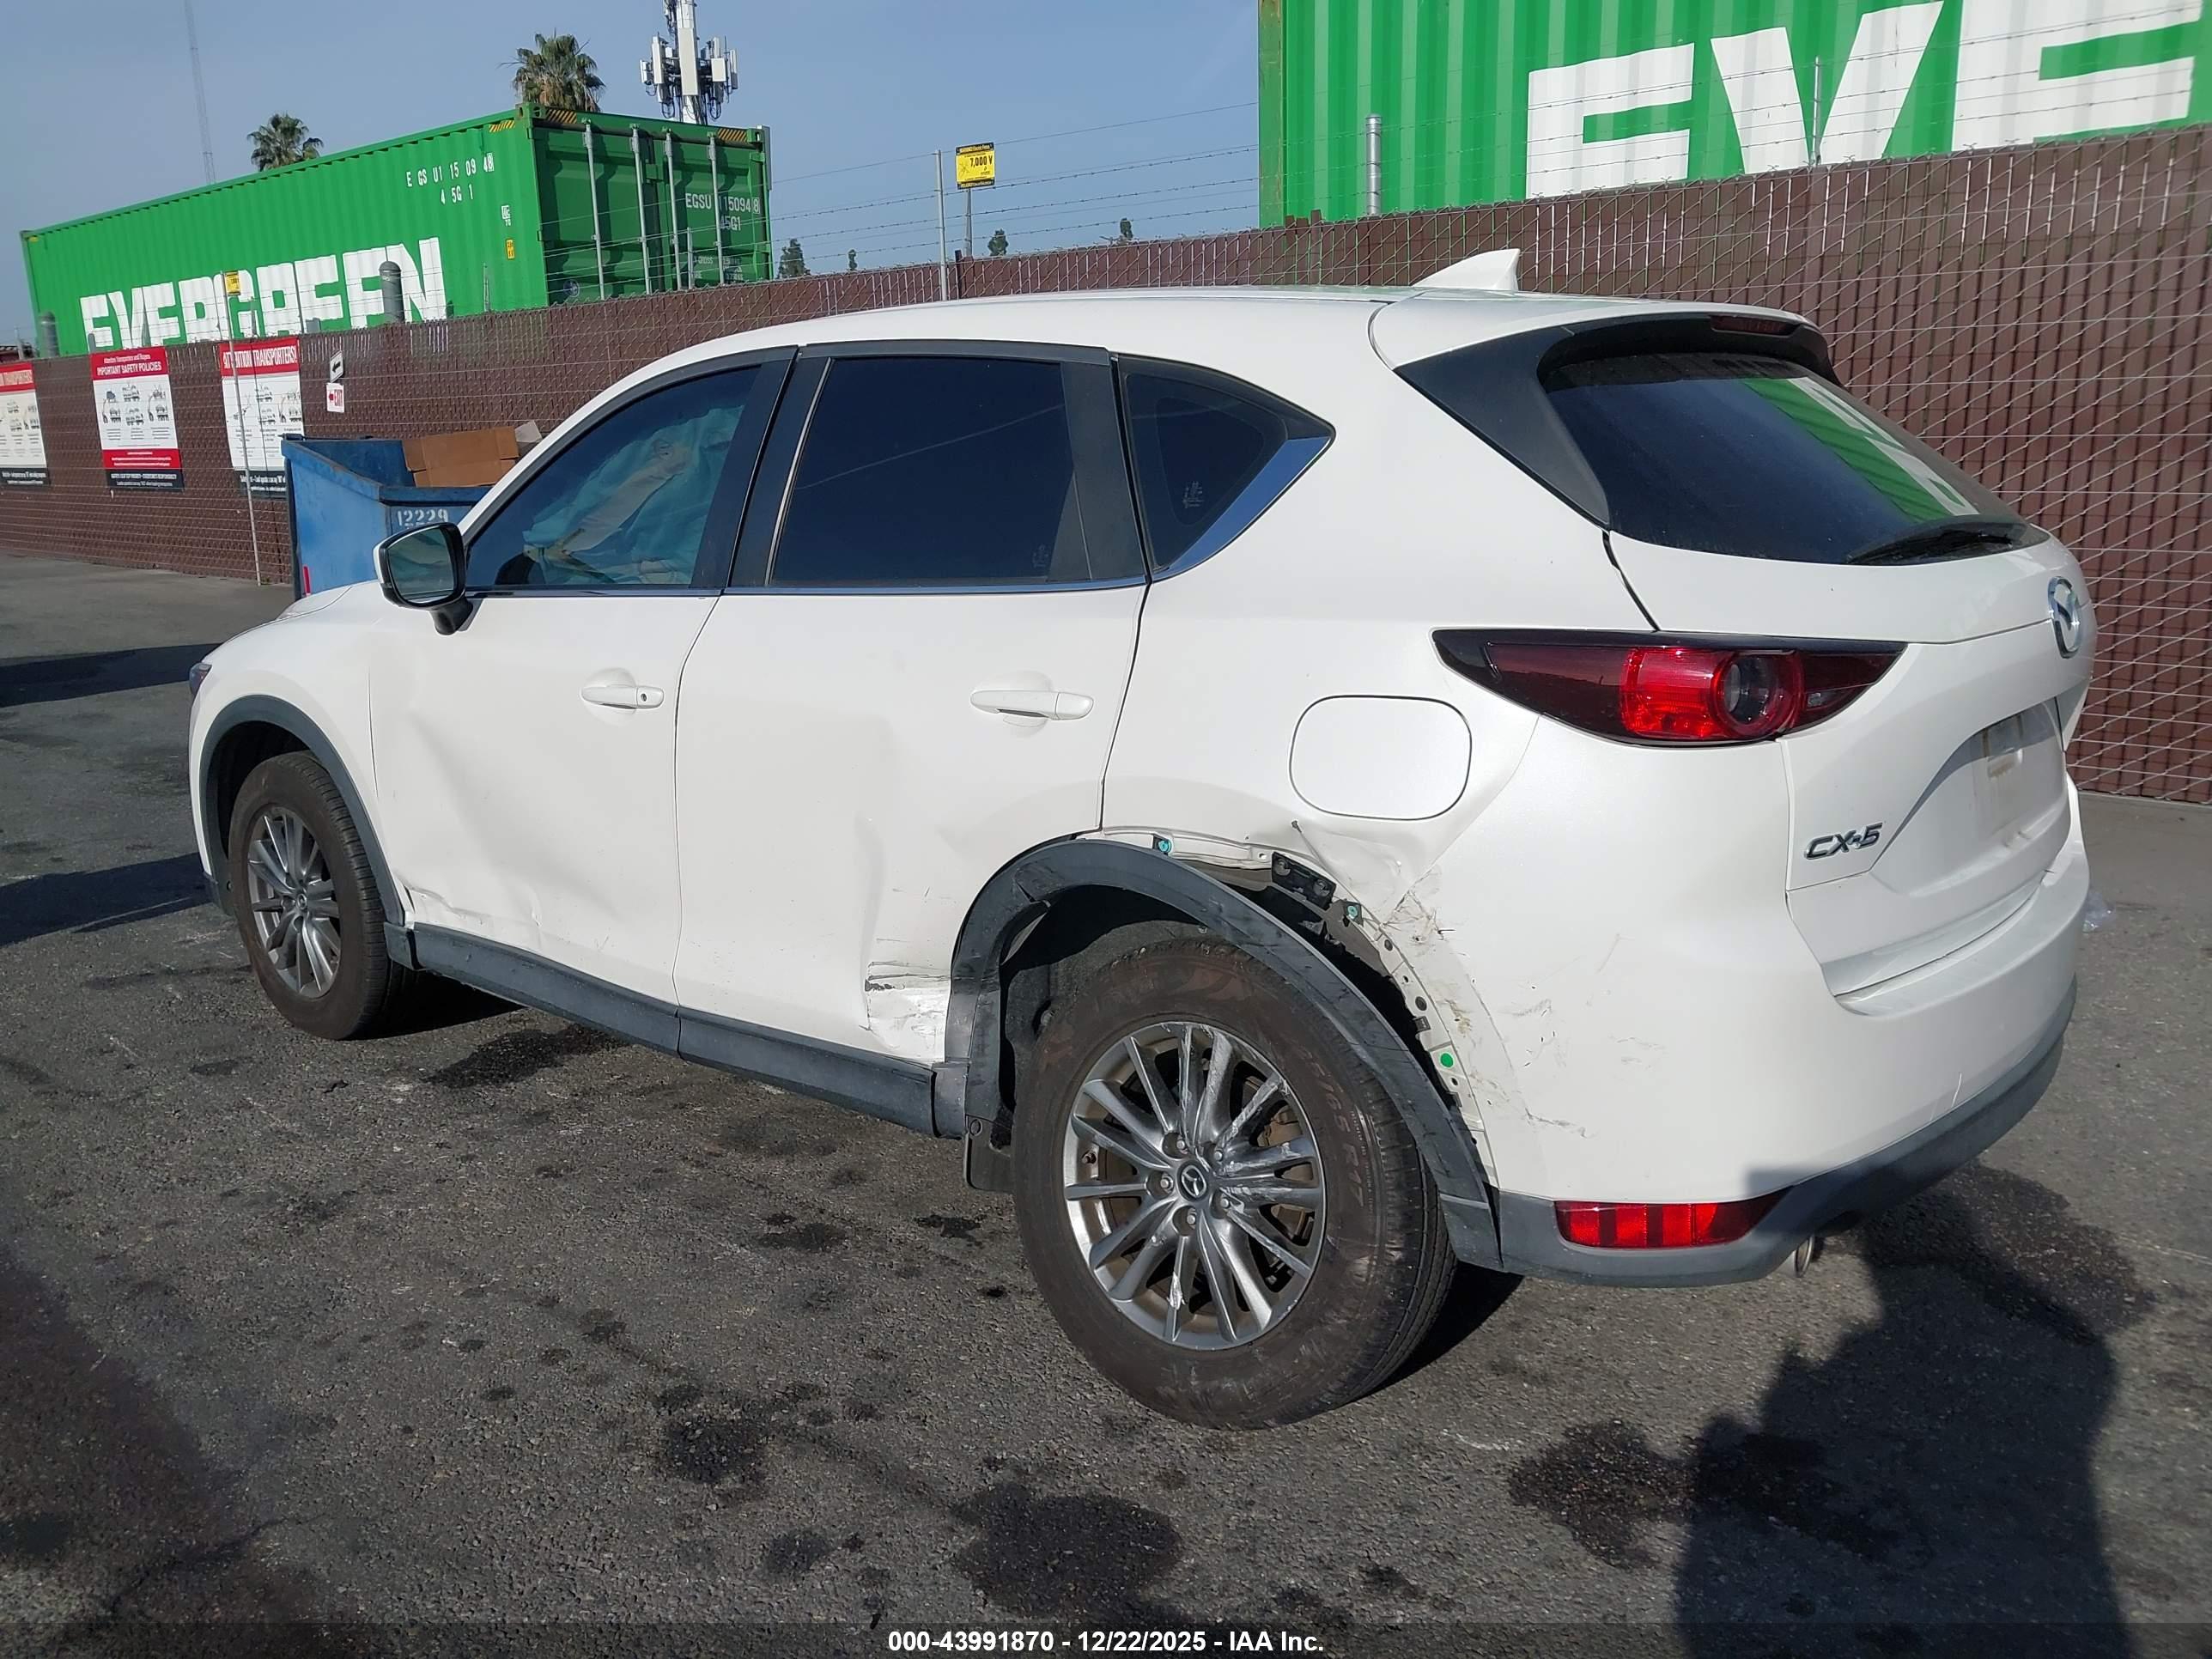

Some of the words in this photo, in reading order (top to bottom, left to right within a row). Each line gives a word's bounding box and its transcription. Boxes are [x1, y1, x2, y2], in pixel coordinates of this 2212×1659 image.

[969, 155, 987, 167] 7,000
[988, 155, 993, 164] V
[685, 193, 712, 210] EGSU
[80, 237, 446, 349] EVERGREEN
[252, 345, 297, 367] TRANSPORTERS!
[96, 365, 121, 376] IMPORTANT
[121, 362, 138, 374] SAFETY
[138, 361, 162, 372] POLICIES
[1804, 823, 1883, 860] CX-5
